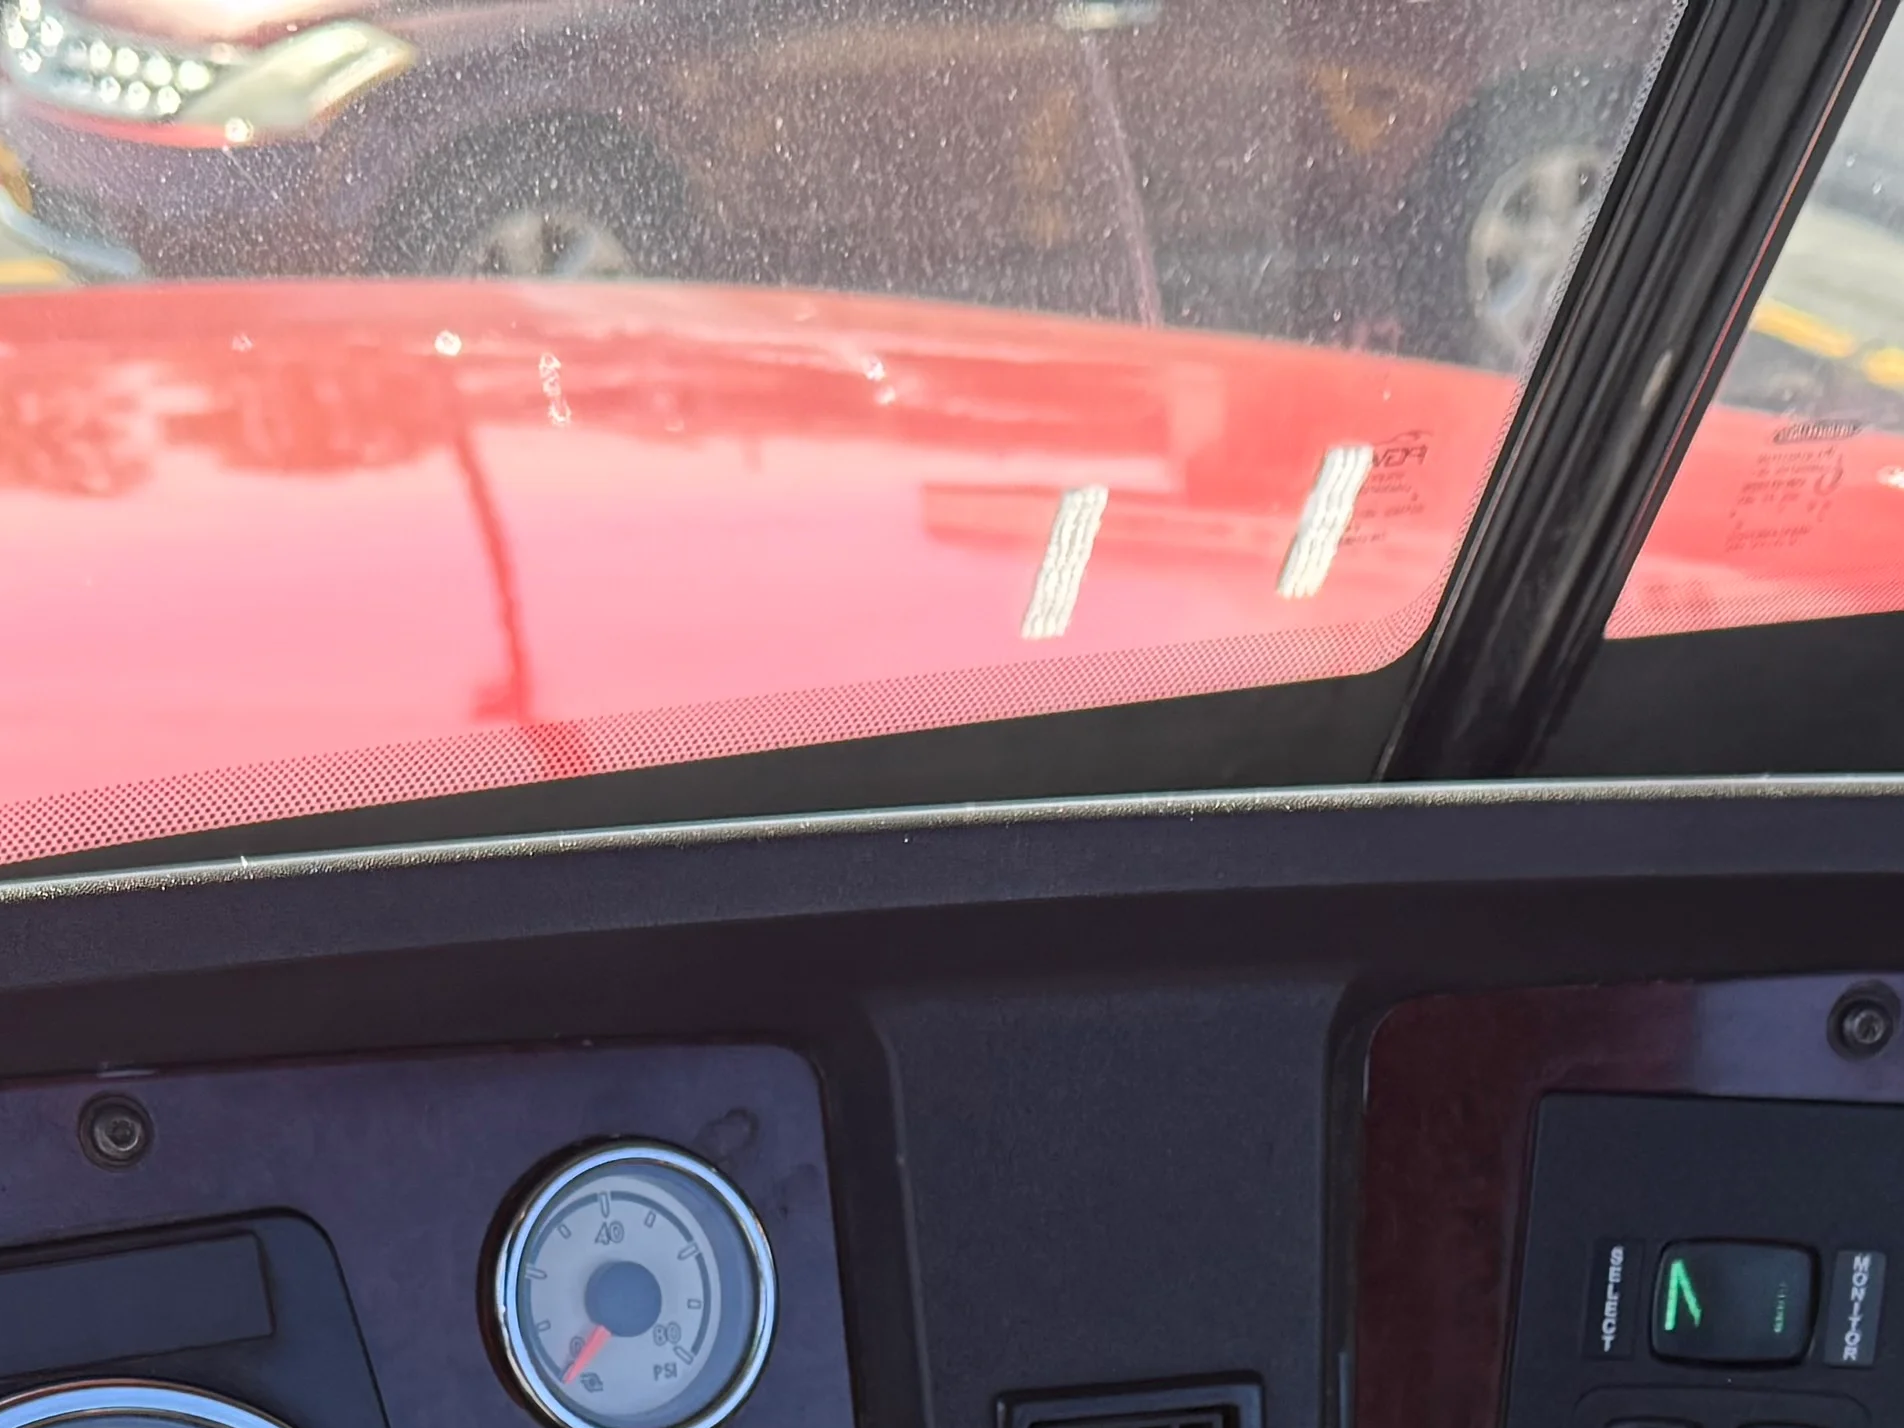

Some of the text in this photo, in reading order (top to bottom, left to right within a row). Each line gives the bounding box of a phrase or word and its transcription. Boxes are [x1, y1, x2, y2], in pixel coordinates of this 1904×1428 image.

[594, 1220, 625, 1246] 40
[1601, 1245, 1624, 1352] SELECT
[1842, 1252, 1871, 1362] MONITOR
[652, 1321, 682, 1347] 80
[653, 1362, 678, 1381] PSI
